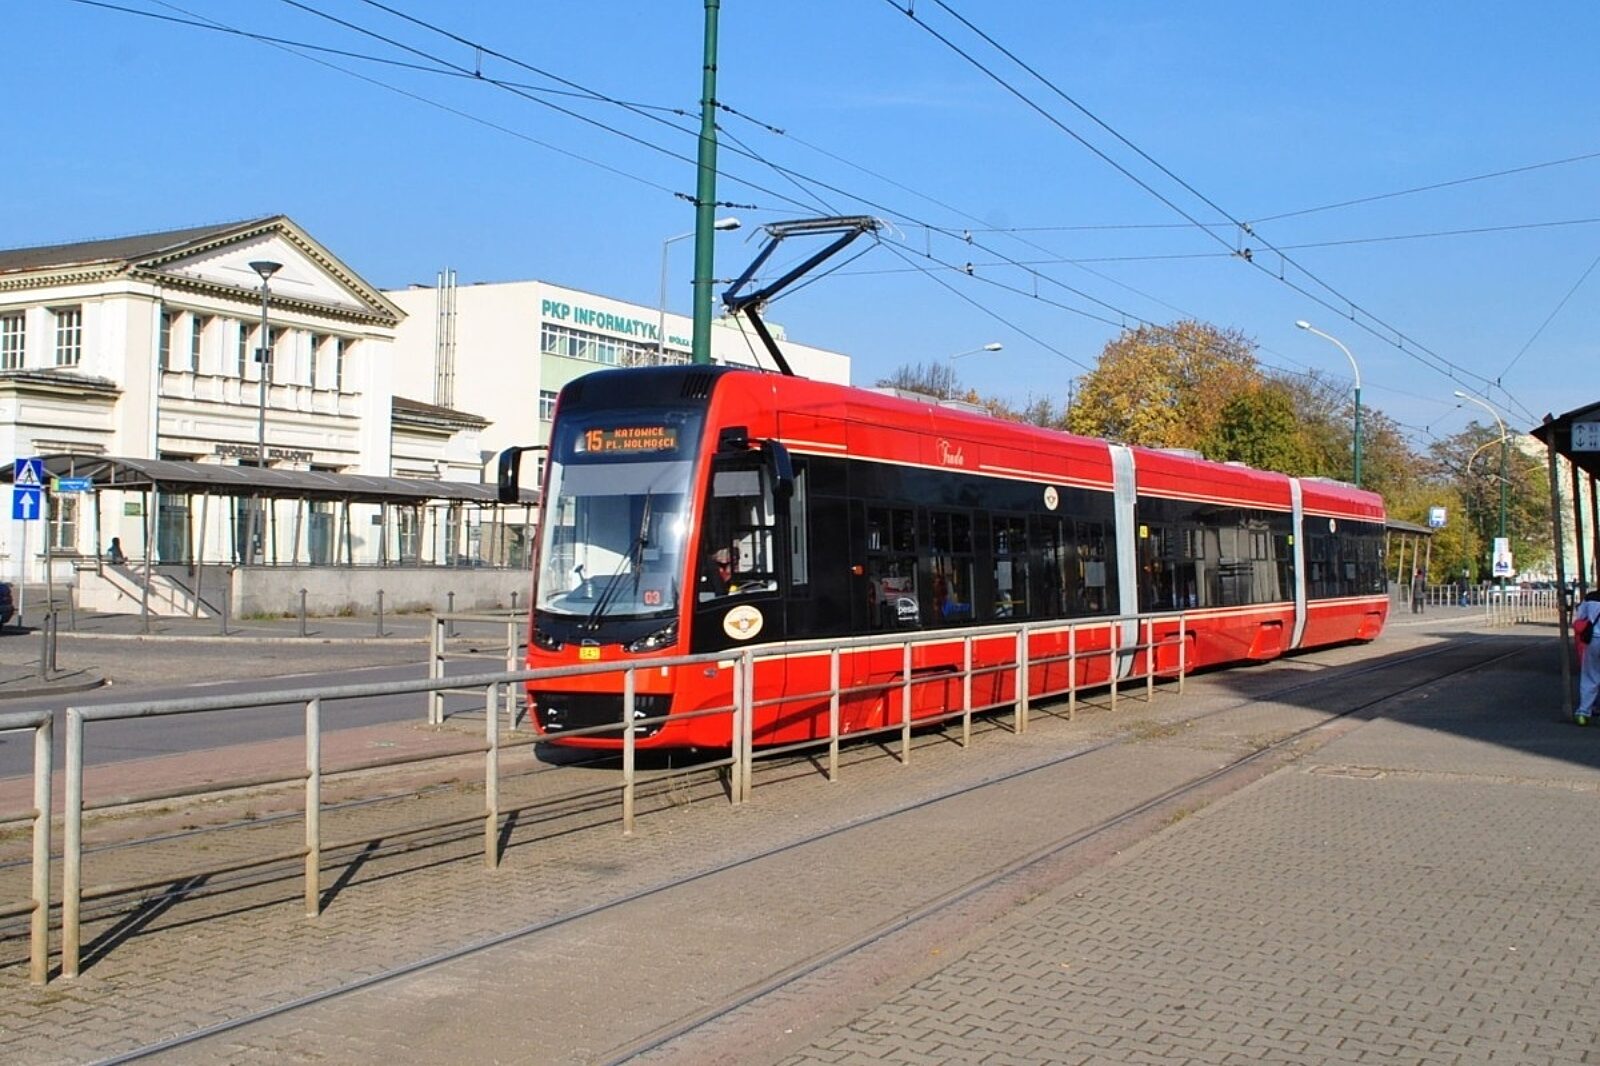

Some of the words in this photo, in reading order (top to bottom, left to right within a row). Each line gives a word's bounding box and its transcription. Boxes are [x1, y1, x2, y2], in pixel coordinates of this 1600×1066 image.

[542, 299, 570, 320] PKP
[585, 430, 603, 451] 15
[614, 427, 664, 438] KATOWICE
